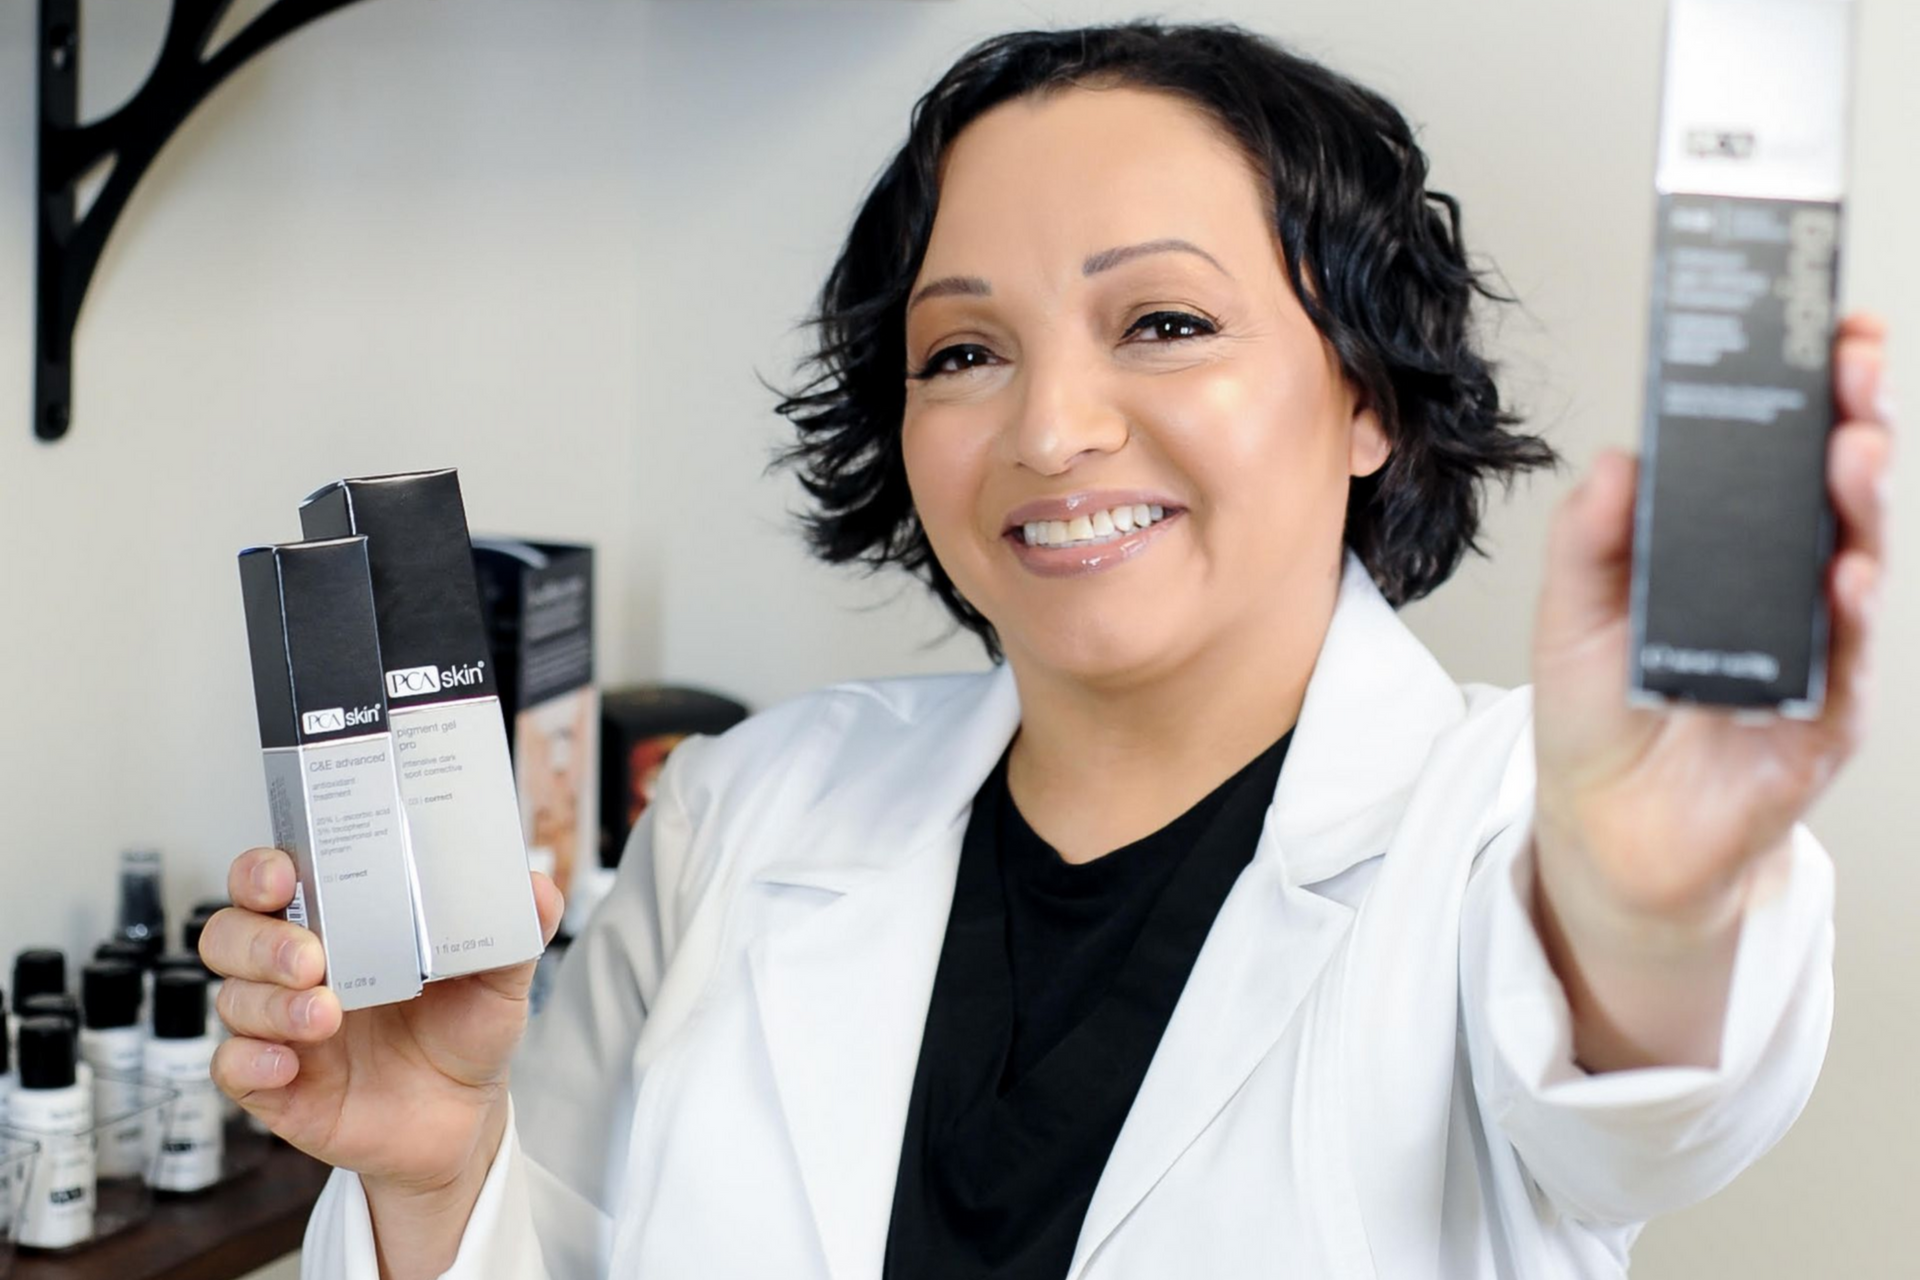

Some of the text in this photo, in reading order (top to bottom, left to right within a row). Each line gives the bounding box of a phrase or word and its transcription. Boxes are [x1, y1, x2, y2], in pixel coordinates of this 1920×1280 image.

[391, 670, 437, 694] PCA
[307, 713, 342, 731] PCA
[396, 719, 457, 738] pigment gel
[398, 741, 417, 752] pro
[309, 751, 386, 772] C&E advanced
[423, 764, 463, 776] corrective
[312, 788, 352, 802] treatment
[424, 792, 453, 804] correct
[338, 869, 368, 881] correct
[450, 943, 460, 953] oz
[343, 980, 353, 989] oz
